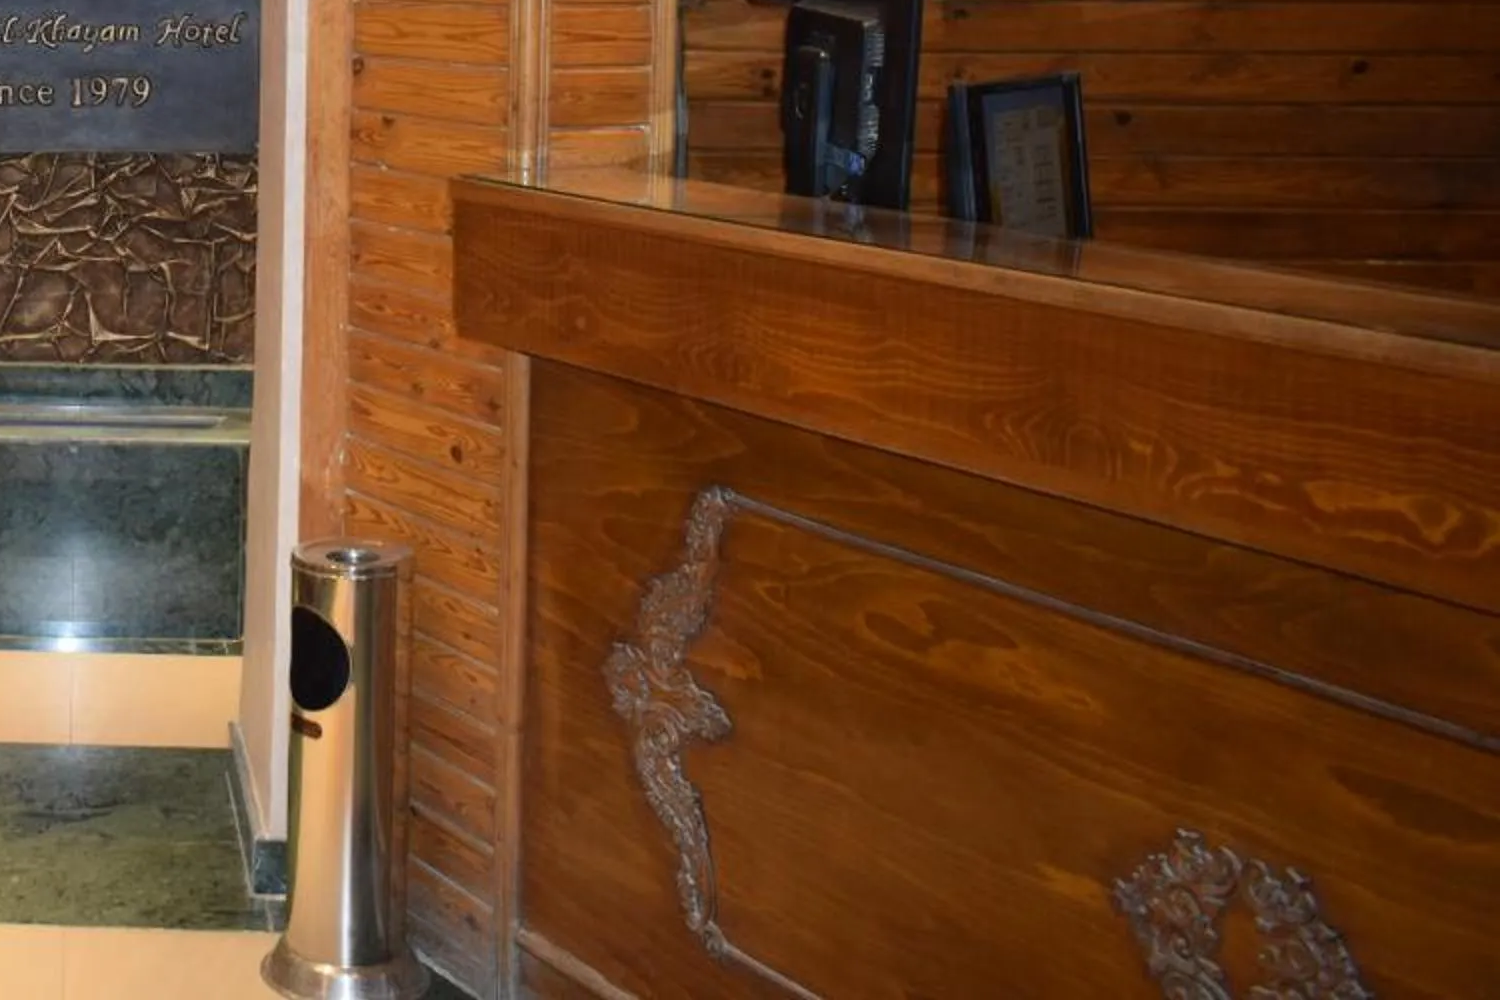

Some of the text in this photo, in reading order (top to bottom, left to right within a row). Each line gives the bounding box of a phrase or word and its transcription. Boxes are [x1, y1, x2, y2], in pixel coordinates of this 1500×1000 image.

[26, 13, 141, 53] Khayam
[156, 12, 247, 47] Hotel
[70, 75, 153, 108] 1979
